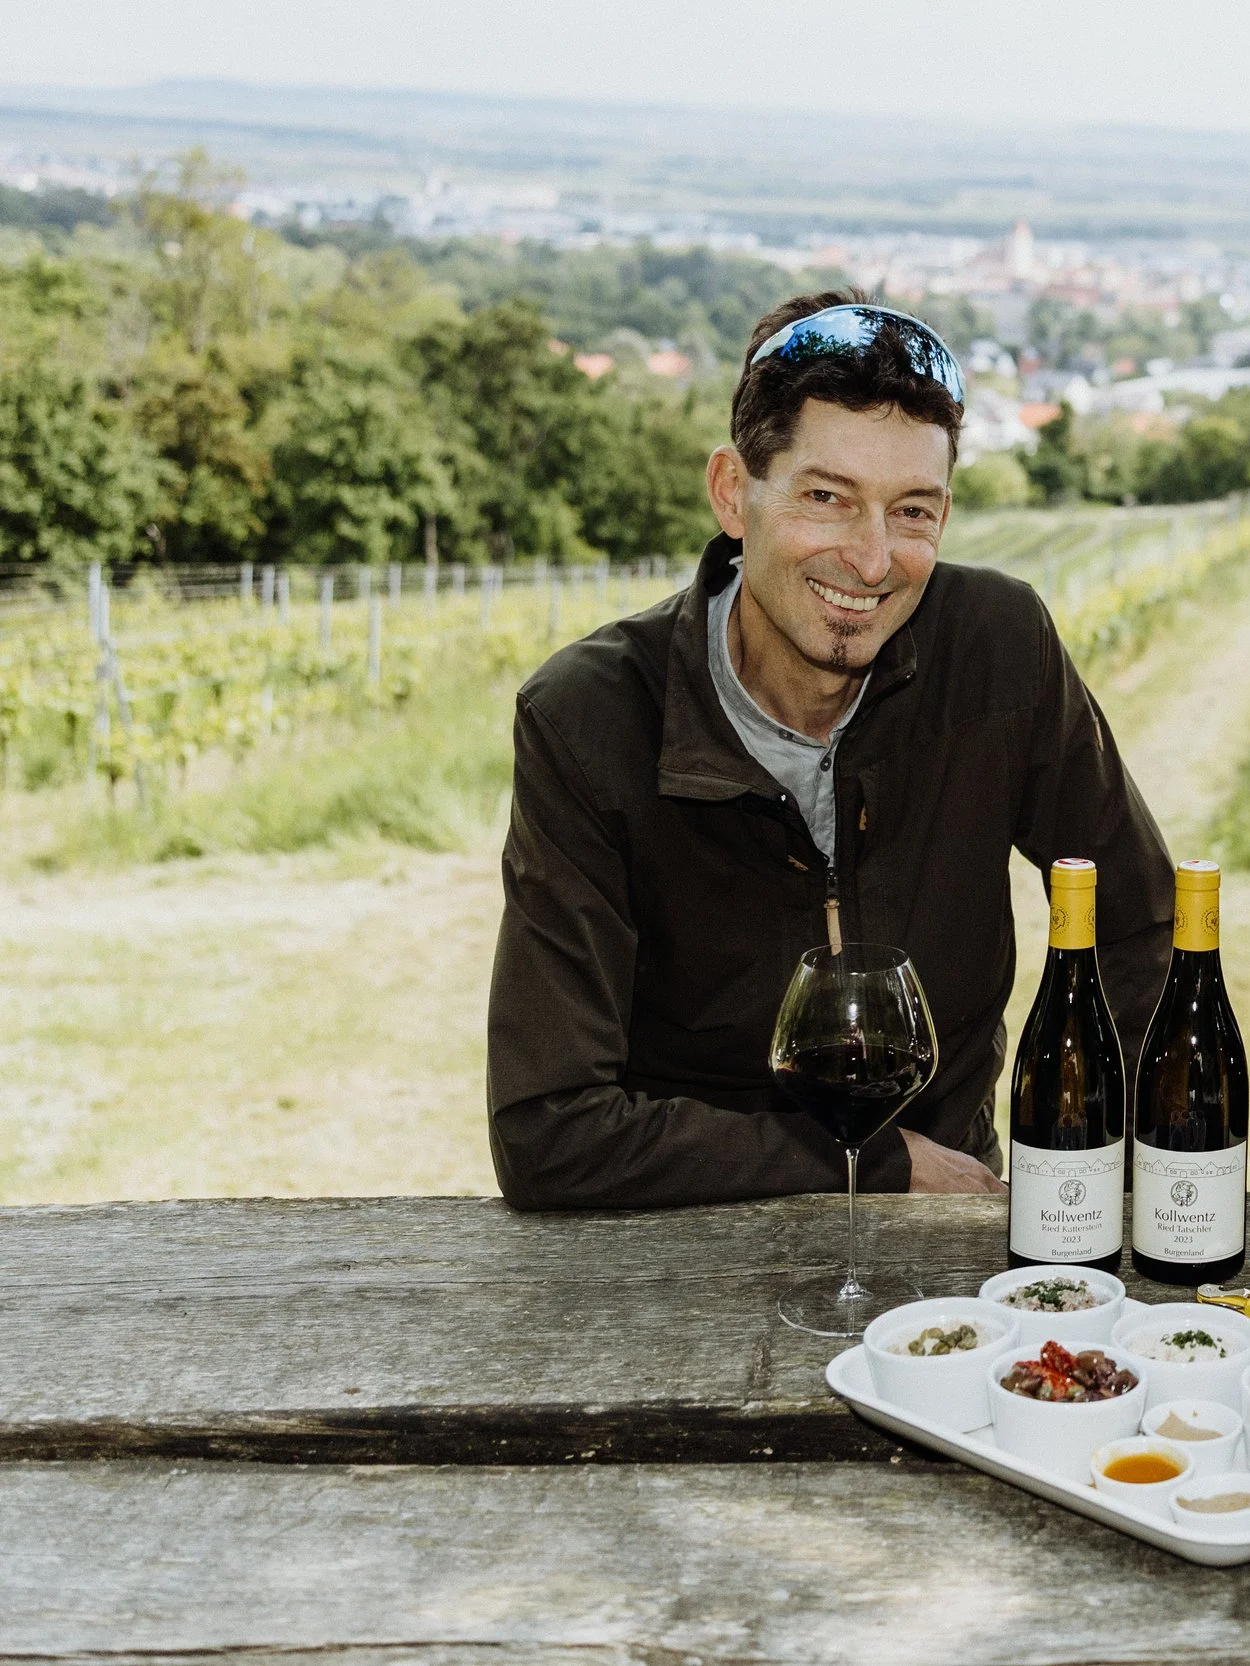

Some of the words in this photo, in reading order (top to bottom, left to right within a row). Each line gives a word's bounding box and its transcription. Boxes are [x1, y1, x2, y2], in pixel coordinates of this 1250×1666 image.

[1041, 1209, 1102, 1222] Kollwentz
[1154, 1207, 1216, 1223] Kollwentz
[1041, 1223, 1060, 1232] Ried
[1157, 1222, 1175, 1232] Ried
[1177, 1224, 1212, 1233] Tatschler
[1061, 1235, 1081, 1244] 2023
[1173, 1235, 1193, 1244] 2023
[1051, 1246, 1092, 1257] Burgenland
[1164, 1247, 1205, 1257] Burgenland
